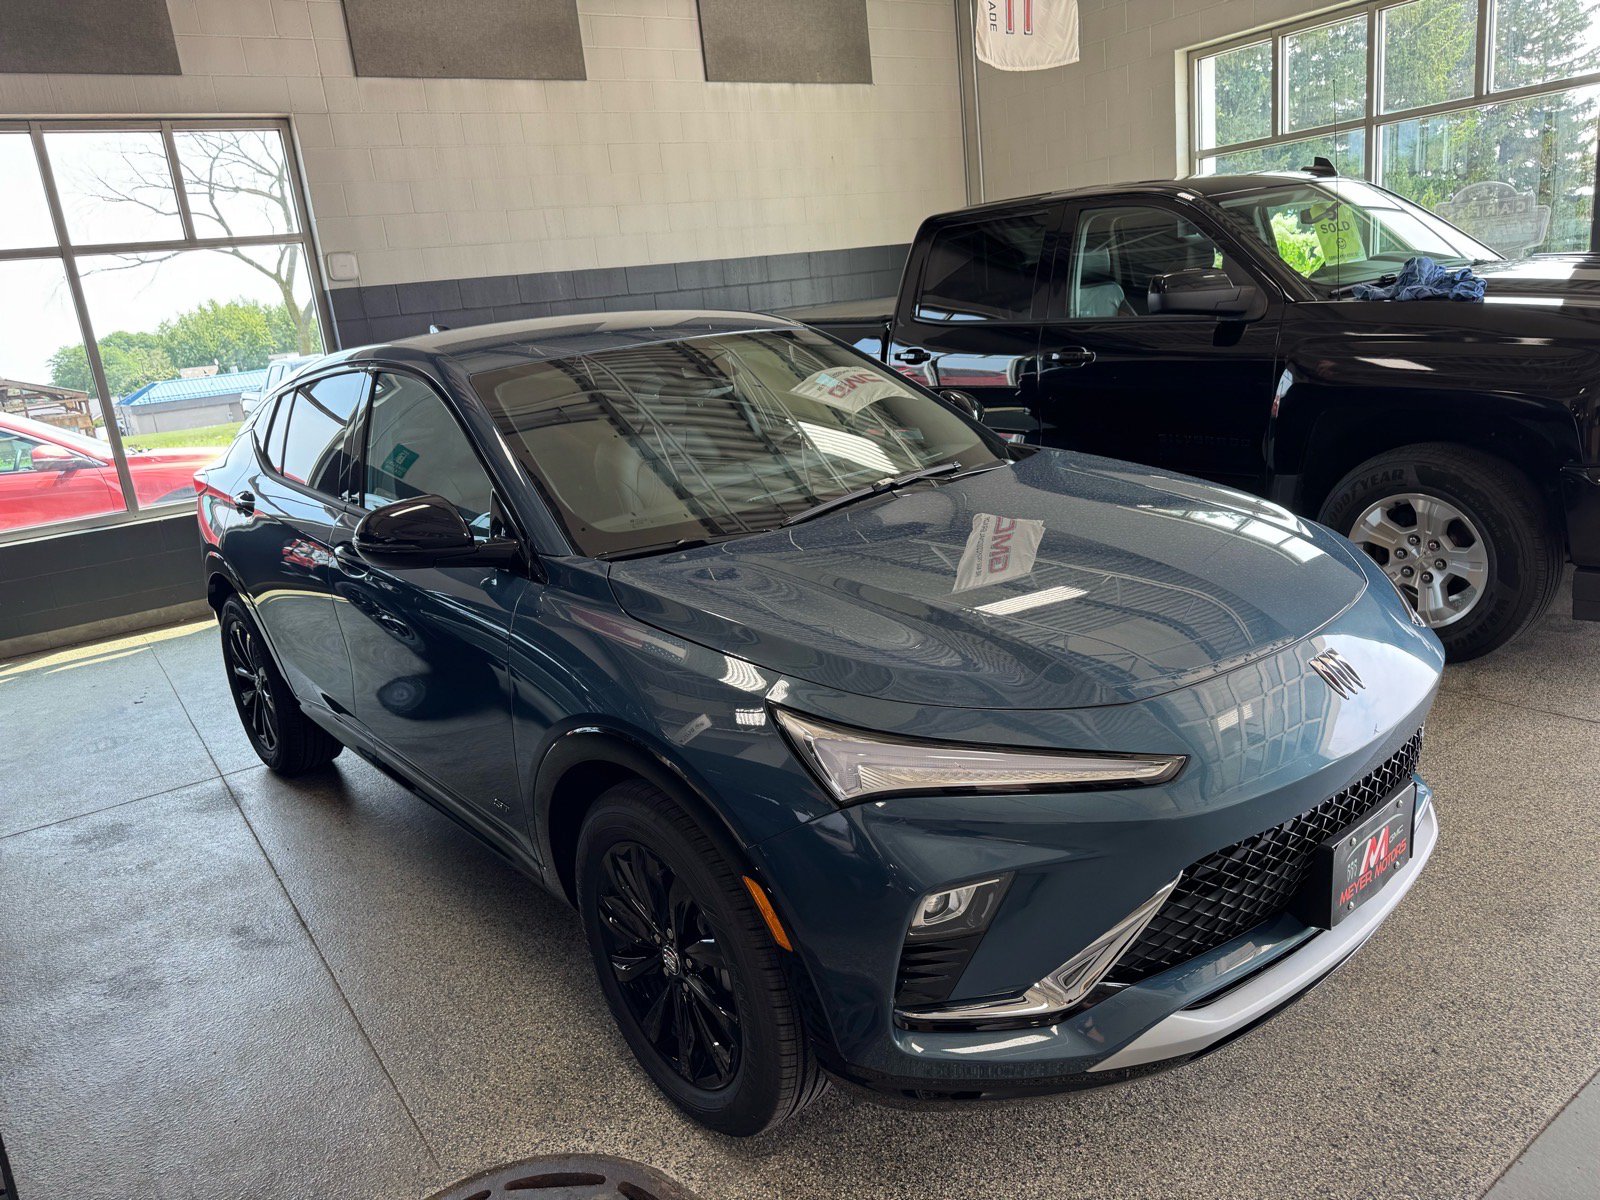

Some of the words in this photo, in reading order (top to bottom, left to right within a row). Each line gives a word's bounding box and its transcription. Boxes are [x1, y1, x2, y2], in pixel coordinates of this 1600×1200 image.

[1320, 220, 1351, 234] SOLD
[1389, 825, 1404, 843] GMC
[1340, 870, 1373, 906] MEYER
[1374, 838, 1407, 879] MOTORS
